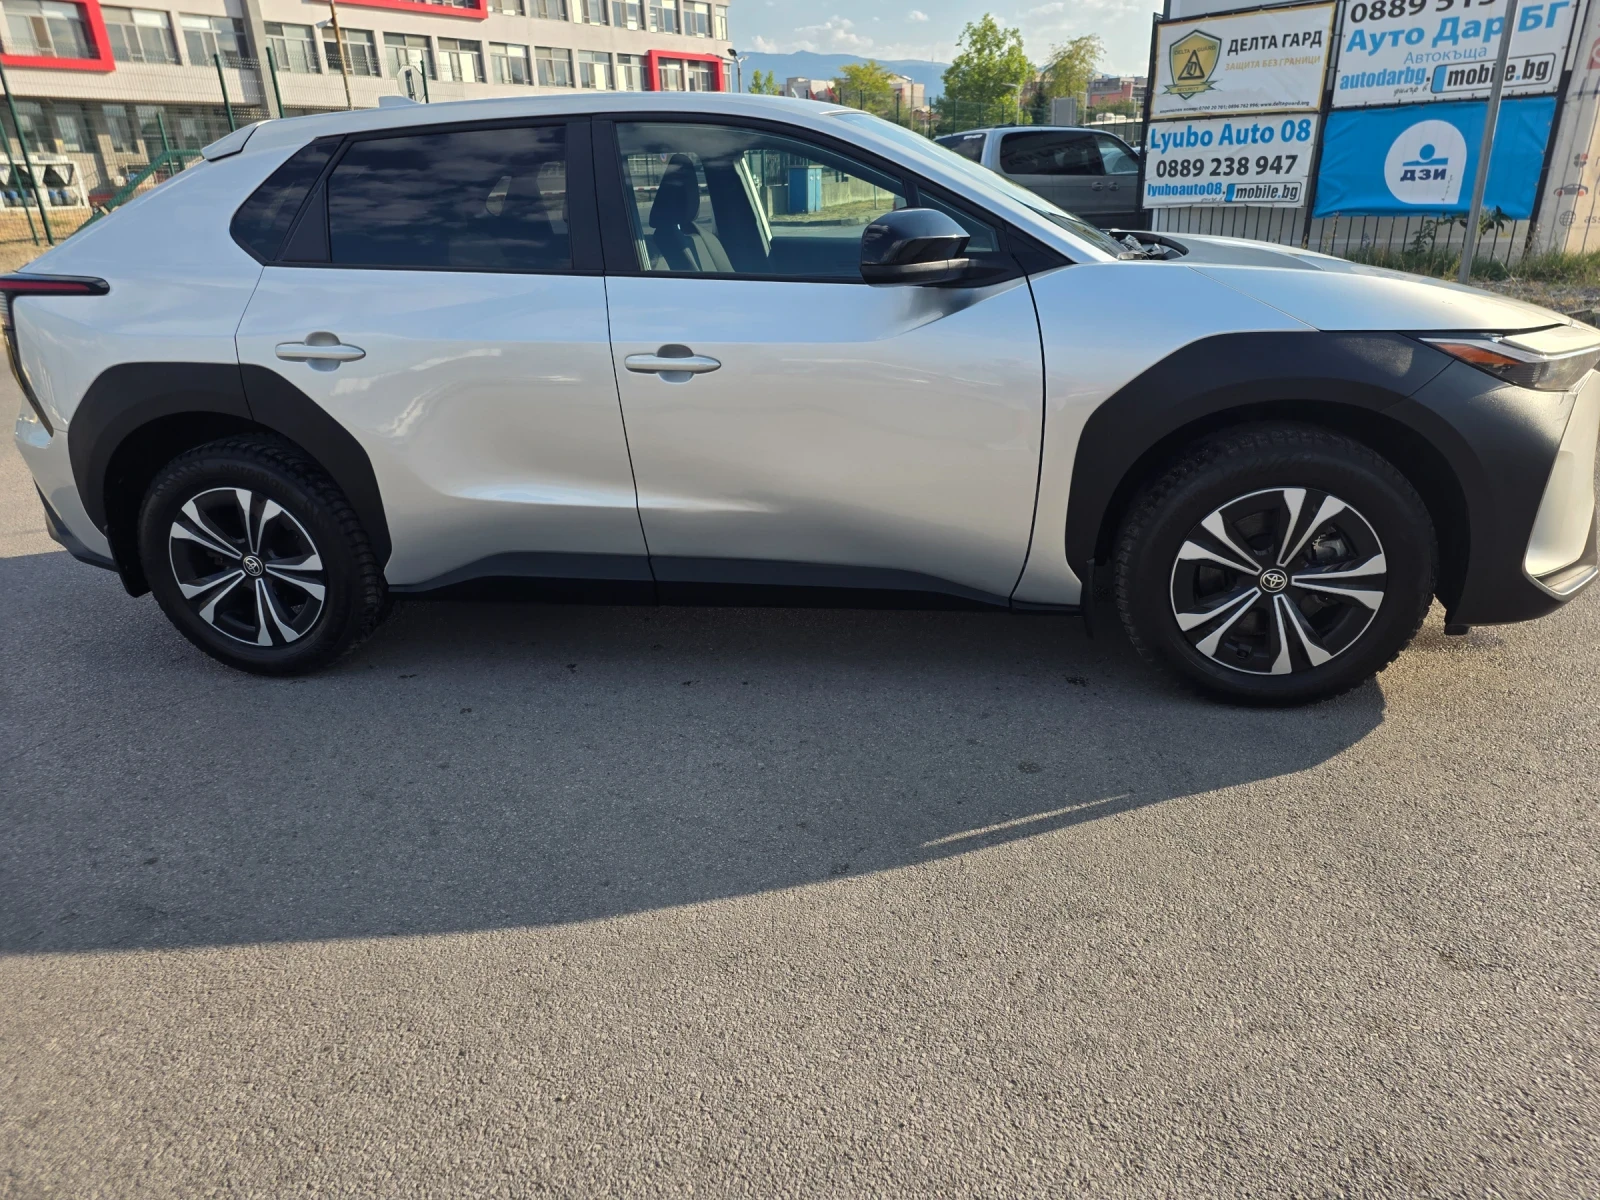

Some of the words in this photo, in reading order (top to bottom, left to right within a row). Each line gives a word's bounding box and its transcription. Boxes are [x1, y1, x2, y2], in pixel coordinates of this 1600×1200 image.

[1350, 0, 1427, 23] 0889
[1346, 27, 1425, 57] Ауто
[1431, 16, 1504, 48] Дар
[1518, 1, 1569, 32] БГ
[1227, 35, 1278, 56] ДЕЛТА
[1282, 30, 1322, 49] ГАРД
[1225, 60, 1260, 71] ЗАЩИТА
[1262, 59, 1278, 68] БЕЗ
[1280, 56, 1320, 67] ГРАНИЦИ
[1403, 46, 1488, 65] Автокъща
[1447, 59, 1549, 87] mobie.bg
[1150, 124, 1213, 154] Lyubo
[1218, 122, 1275, 146] Auto
[1281, 118, 1311, 142] 08
[1156, 158, 1205, 178] 0889
[1209, 156, 1250, 176] 238
[1255, 154, 1299, 175] 947
[1400, 168, 1447, 182] ДЗИ
[1235, 184, 1299, 200] mobile.bg
